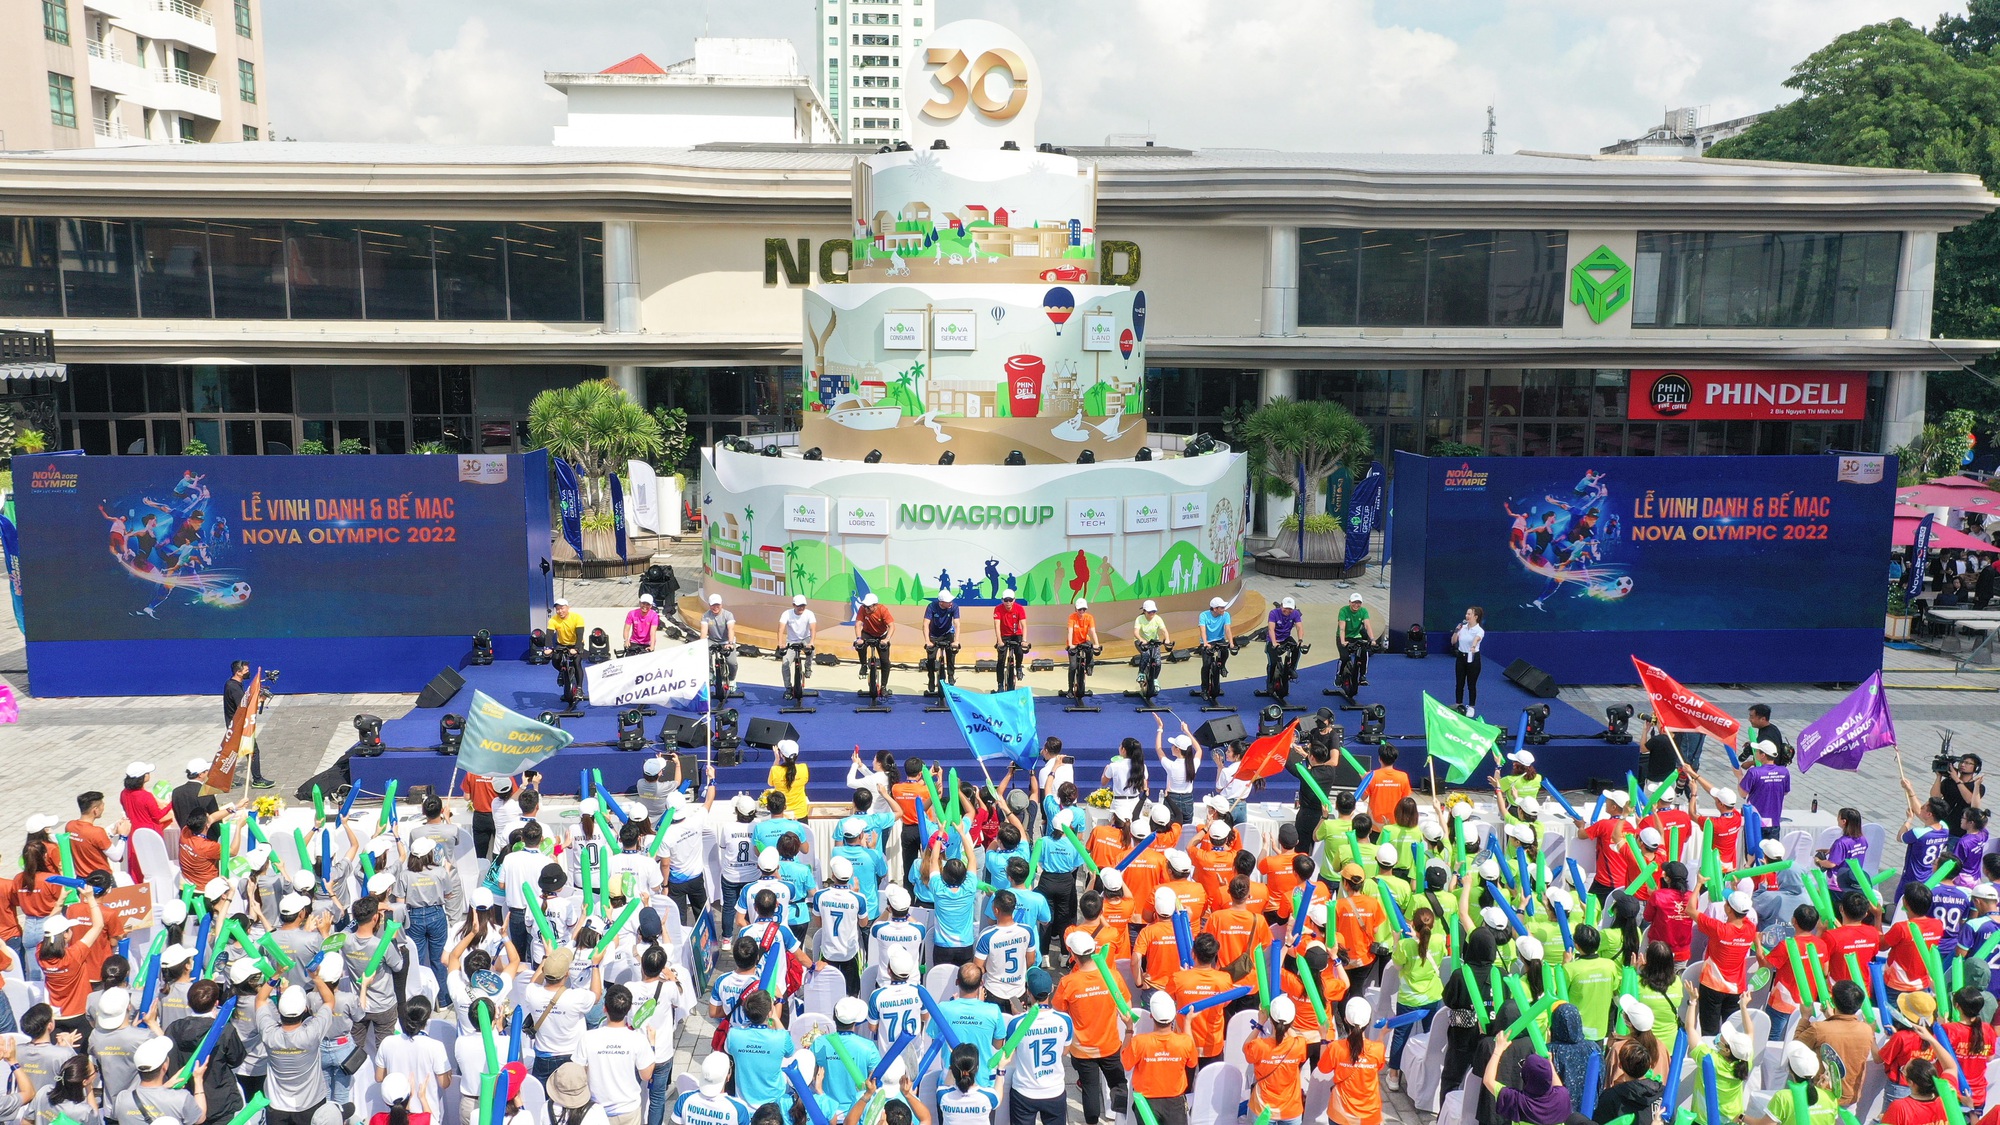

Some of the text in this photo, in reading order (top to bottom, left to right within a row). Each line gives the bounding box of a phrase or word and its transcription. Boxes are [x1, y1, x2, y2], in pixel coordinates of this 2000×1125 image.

[1658, 384, 1686, 392] PHIN
[1705, 383, 1848, 405] PHINDELI
[1657, 394, 1684, 402] DELI
[32, 471, 61, 480] NOVA
[1446, 470, 1472, 478] NOVA
[32, 480, 77, 488] OLYMPIC
[241, 492, 454, 524] LỄ VINH DANH & BẾ MẠC
[900, 504, 1054, 525] NOVAGROUP
[1634, 490, 1830, 522] LỄ VINH DANH & BẾ MẠC
[242, 527, 456, 544] NOVA OLYMPIC 2022
[1632, 524, 1828, 541] NOVA OLYMPIC 2022
[635, 668, 674, 686] ĐOÀN
[615, 678, 697, 706] NOVALAND 5
[1672, 692, 1704, 708] ĐOÀN
[1674, 703, 1733, 728] CONSUMER
[1836, 712, 1864, 736] ĐOÀN
[508, 730, 544, 742] ĐOÀN
[1016, 732, 1022, 743] 6
[1445, 732, 1473, 750] NOVA
[480, 738, 544, 755] NOVALAND
[1820, 738, 1846, 758] NOVA
[737, 840, 750, 862] 8
[822, 901, 850, 910] NOVALAND
[830, 910, 844, 936] 7
[880, 934, 913, 942] NOVALAND
[994, 938, 1022, 949] NOVALAND
[1005, 948, 1018, 974] 5
[880, 998, 914, 1008] NOVALAND
[883, 1009, 917, 1042] 76
[1029, 1038, 1057, 1068] 13
[688, 1104, 730, 1120] NOVALAND 6
[942, 1104, 980, 1114] NOVALAND
